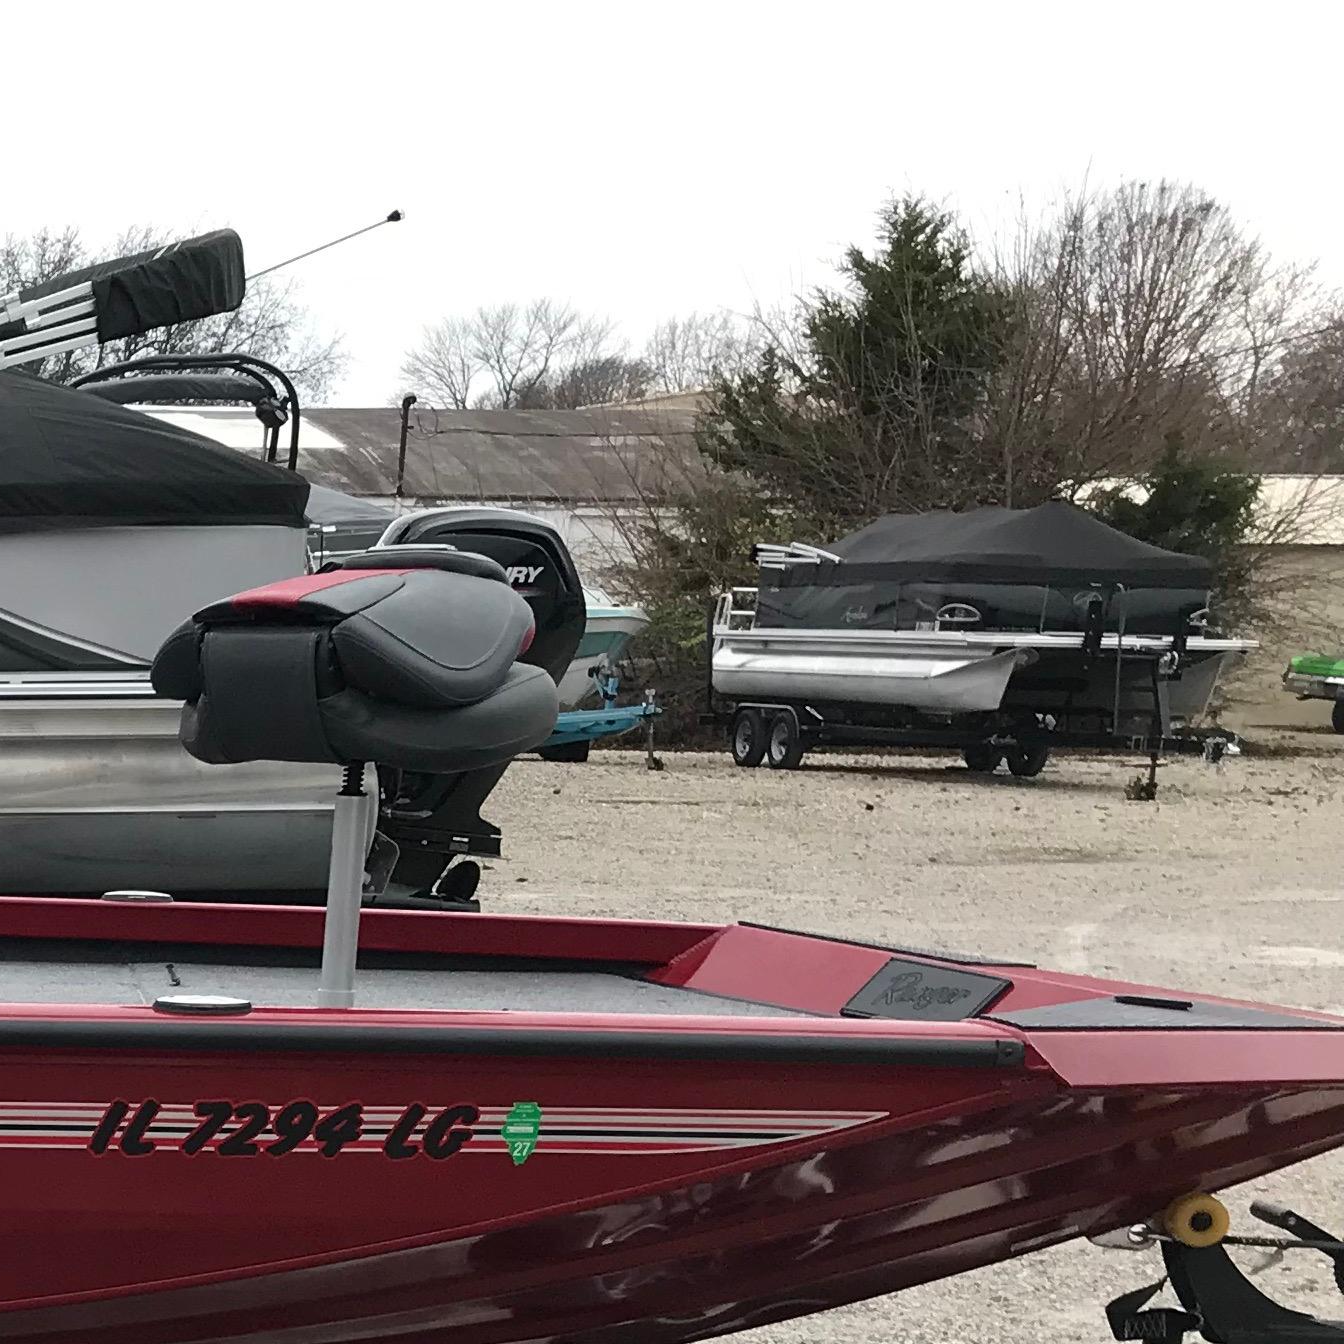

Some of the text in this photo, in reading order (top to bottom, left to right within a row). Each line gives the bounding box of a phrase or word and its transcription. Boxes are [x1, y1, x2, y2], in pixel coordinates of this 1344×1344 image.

[88, 1098, 161, 1156] IL
[181, 1098, 365, 1159] 7294
[383, 1103, 480, 1160] LG
[512, 1142, 531, 1157] 27
